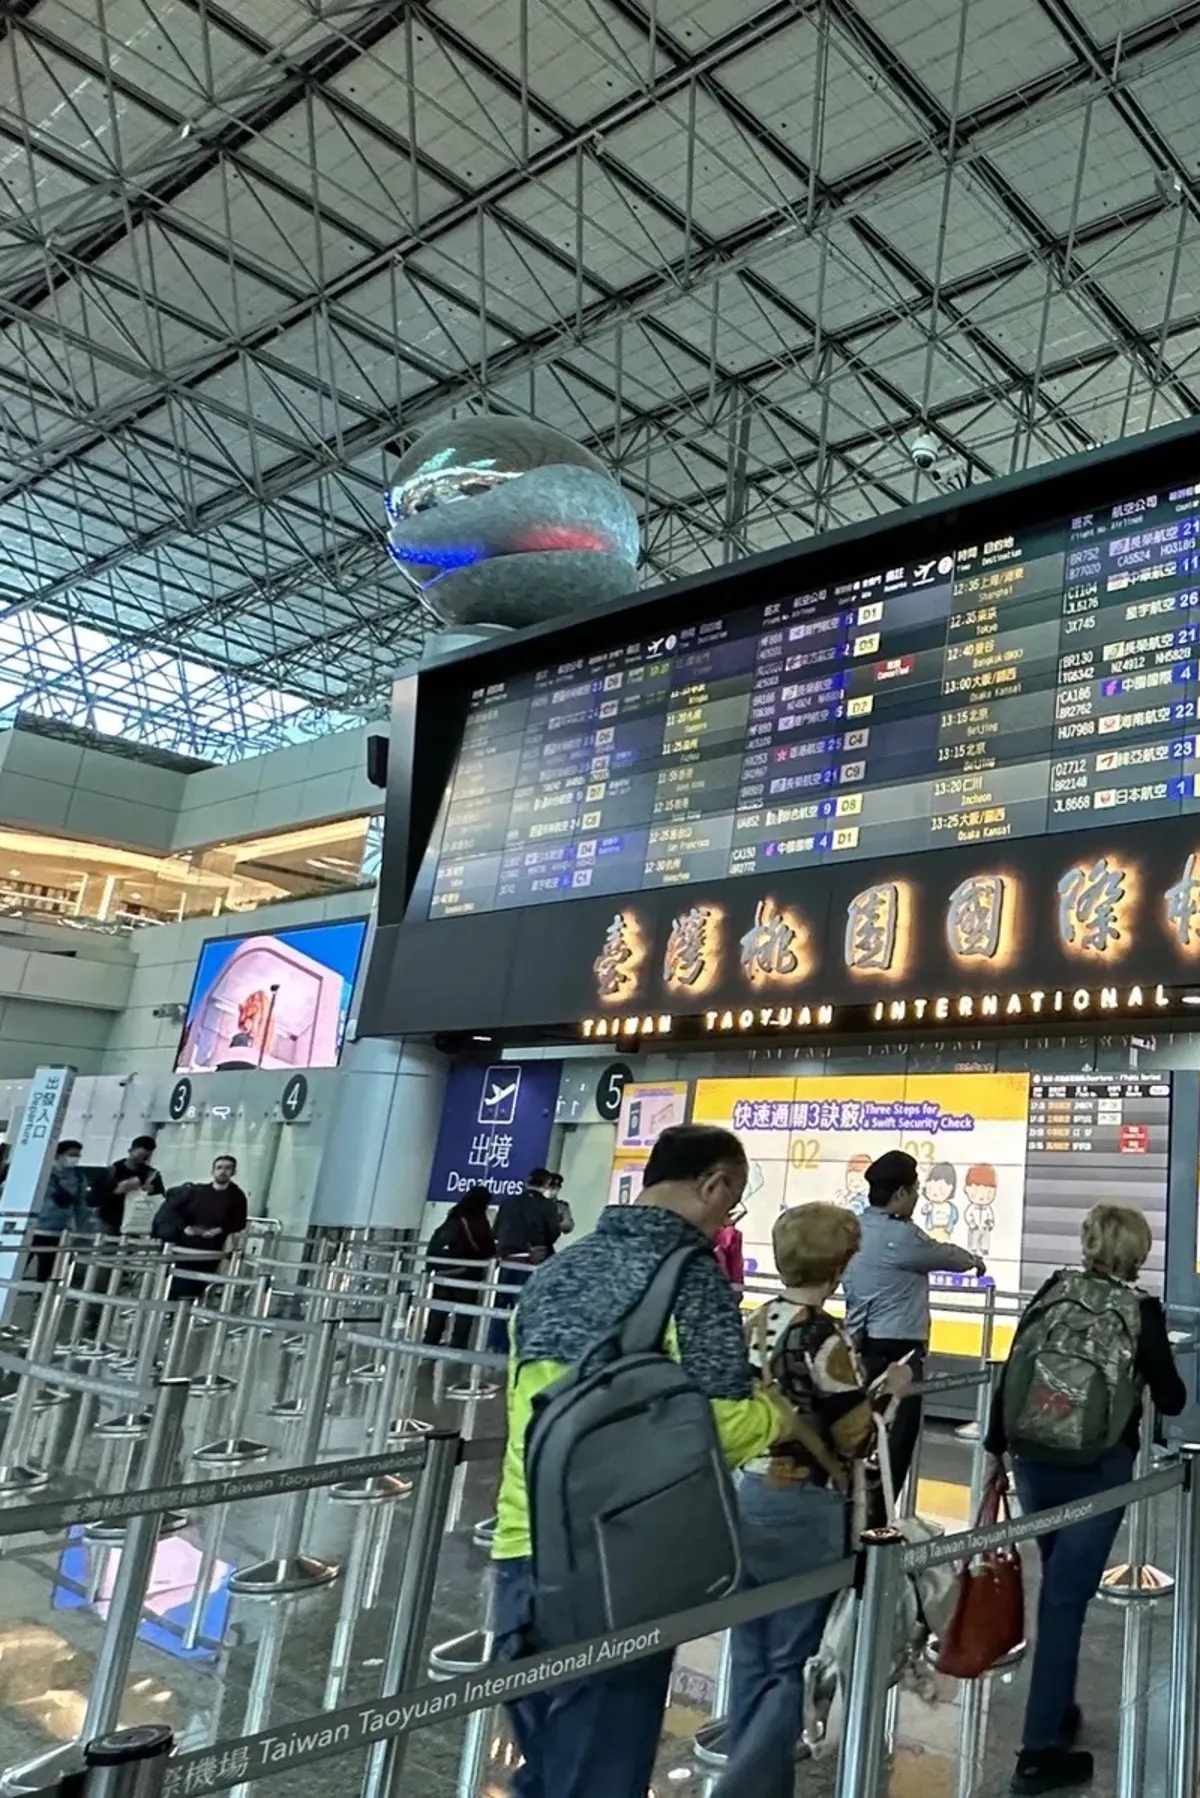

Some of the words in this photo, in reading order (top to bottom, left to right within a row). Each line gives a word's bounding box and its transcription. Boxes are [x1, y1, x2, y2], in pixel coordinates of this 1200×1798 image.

[1183, 520, 1200, 535] 21
[1183, 557, 1198, 571] 11
[1065, 616, 1096, 634] JX745
[1180, 592, 1199, 608] 26
[1178, 629, 1196, 643] 21
[1180, 666, 1191, 680] 4
[945, 677, 971, 695] 13:00
[1175, 703, 1194, 718] 22
[941, 711, 968, 728] 13:15
[848, 734, 863, 746] C4
[938, 744, 965, 761] 13:15
[1174, 742, 1193, 757] 23
[934, 780, 962, 796] 13:20
[1115, 784, 1167, 804] 日本航空
[1176, 781, 1185, 794] 1
[823, 803, 832, 815] 9
[931, 814, 959, 831] 13:25
[819, 835, 828, 848] 4
[837, 833, 852, 845] D1
[581, 1014, 673, 1038] TAIWAN
[705, 1004, 834, 1030] TAOYUAN
[874, 985, 1170, 1022] INTERNATIONAL
[172, 1085, 188, 1113] 3
[285, 1082, 301, 1111] 4
[604, 1074, 623, 1109] 5
[864, 1104, 892, 1116] Three
[893, 1104, 920, 1117] Steps
[922, 1104, 938, 1115] for
[871, 1116, 897, 1129] Swift
[899, 1116, 939, 1132] Security
[941, 1116, 973, 1129] Check
[468, 1133, 513, 1168] 出境
[791, 1139, 821, 1169] 02
[220, 1480, 274, 1498] Taiwan
[278, 1472, 339, 1493] Taoyuan
[929, 1537, 965, 1558] Taiwan
[967, 1528, 1008, 1549] Taoyuan
[1007, 1515, 1063, 1539] International
[1063, 1503, 1093, 1523] Airport
[258, 1722, 350, 1764] Taiwan
[360, 1692, 458, 1737] Taoyuan
[463, 1645, 594, 1704] International
[594, 1627, 662, 1662] Airport
